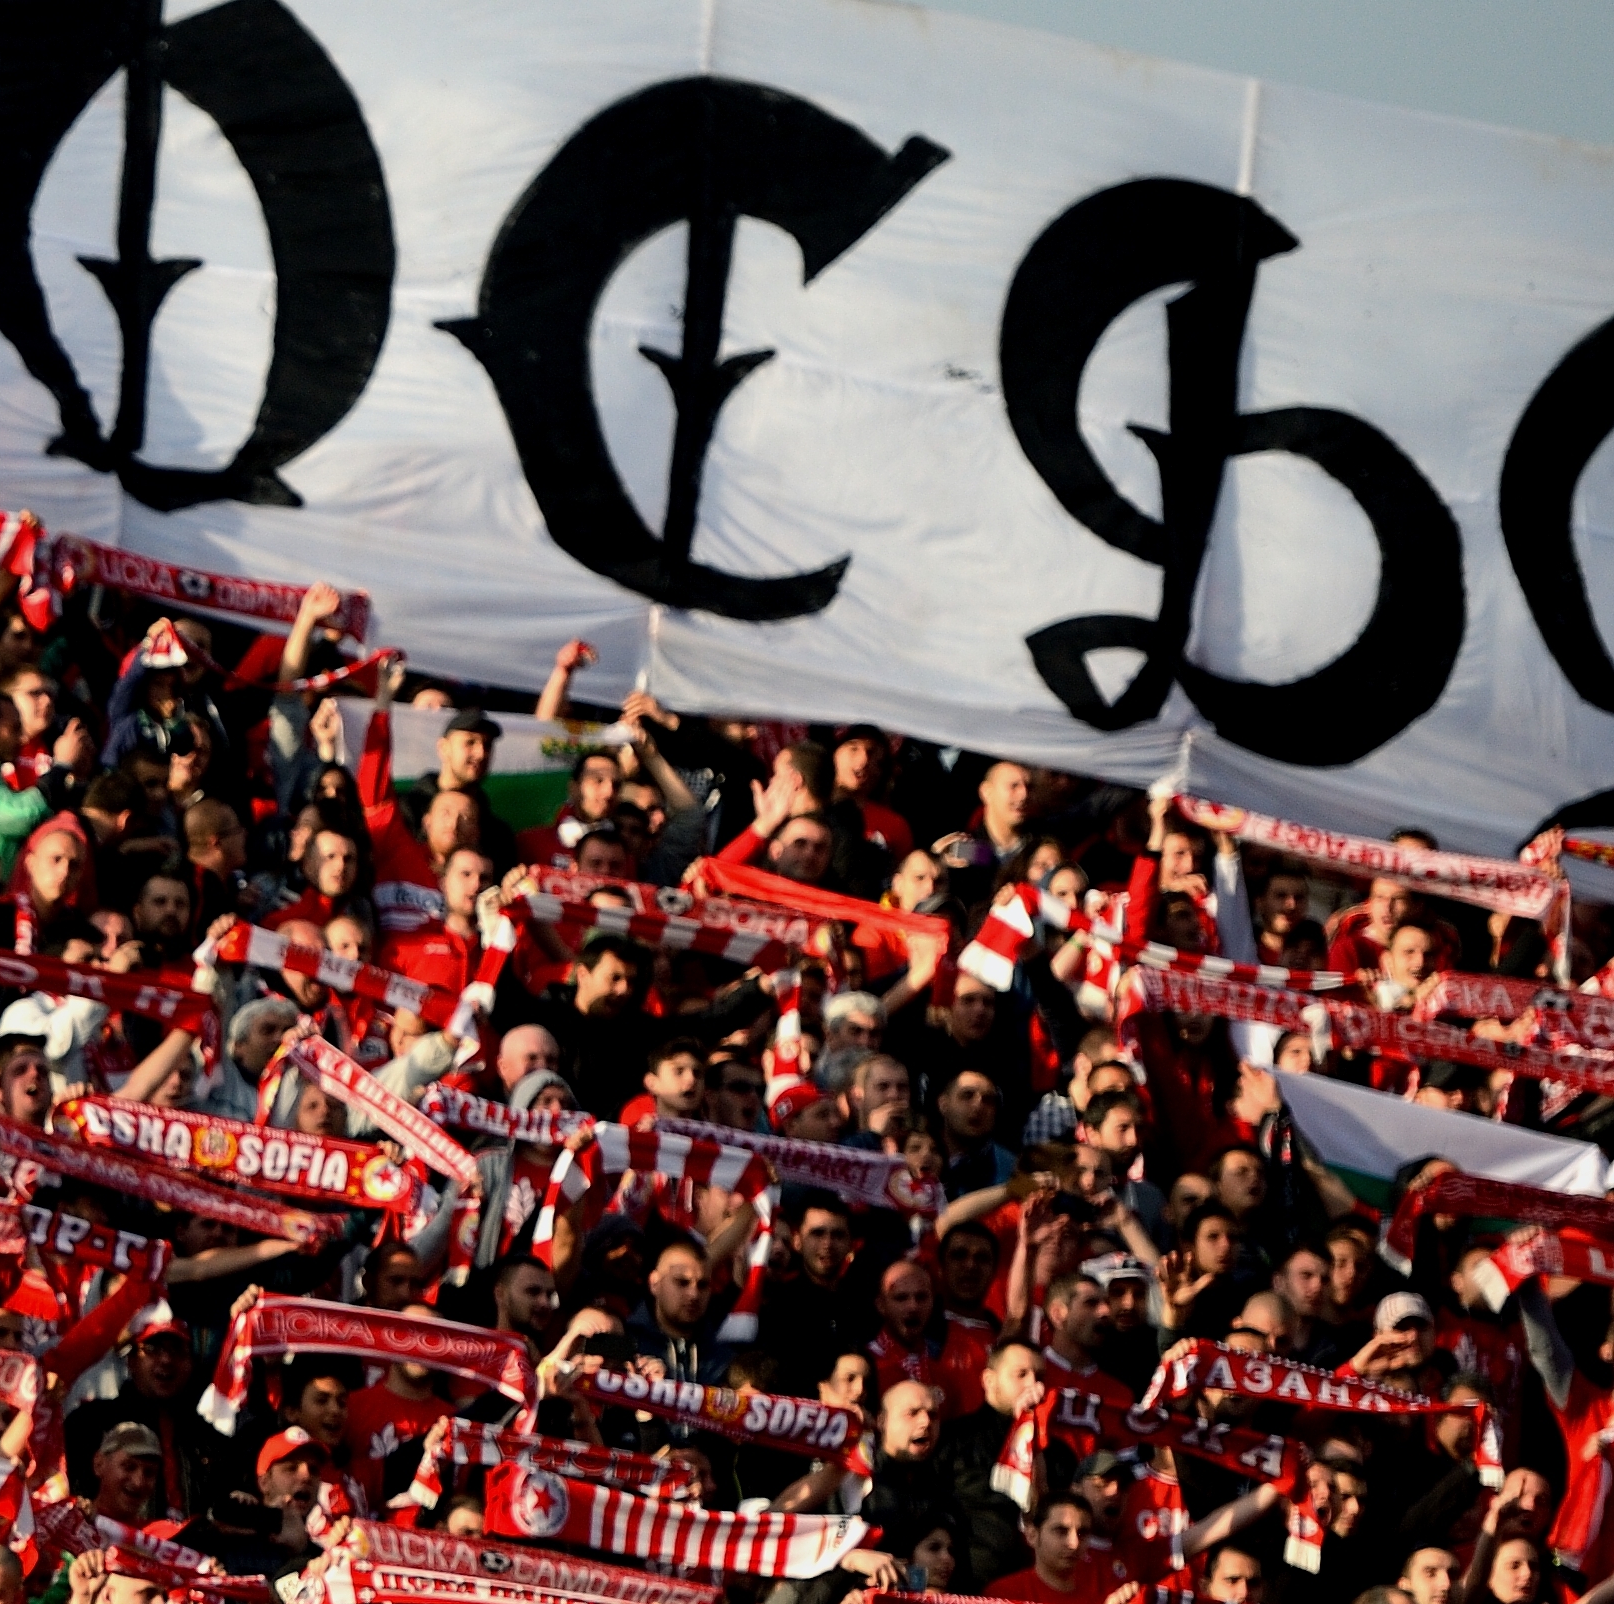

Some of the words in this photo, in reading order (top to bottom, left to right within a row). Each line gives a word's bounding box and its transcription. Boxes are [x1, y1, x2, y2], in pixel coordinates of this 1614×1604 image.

[84, 1101, 194, 1157] CSKA
[236, 1131, 348, 1193] SOFIA
[744, 1392, 850, 1449] SOFIA
